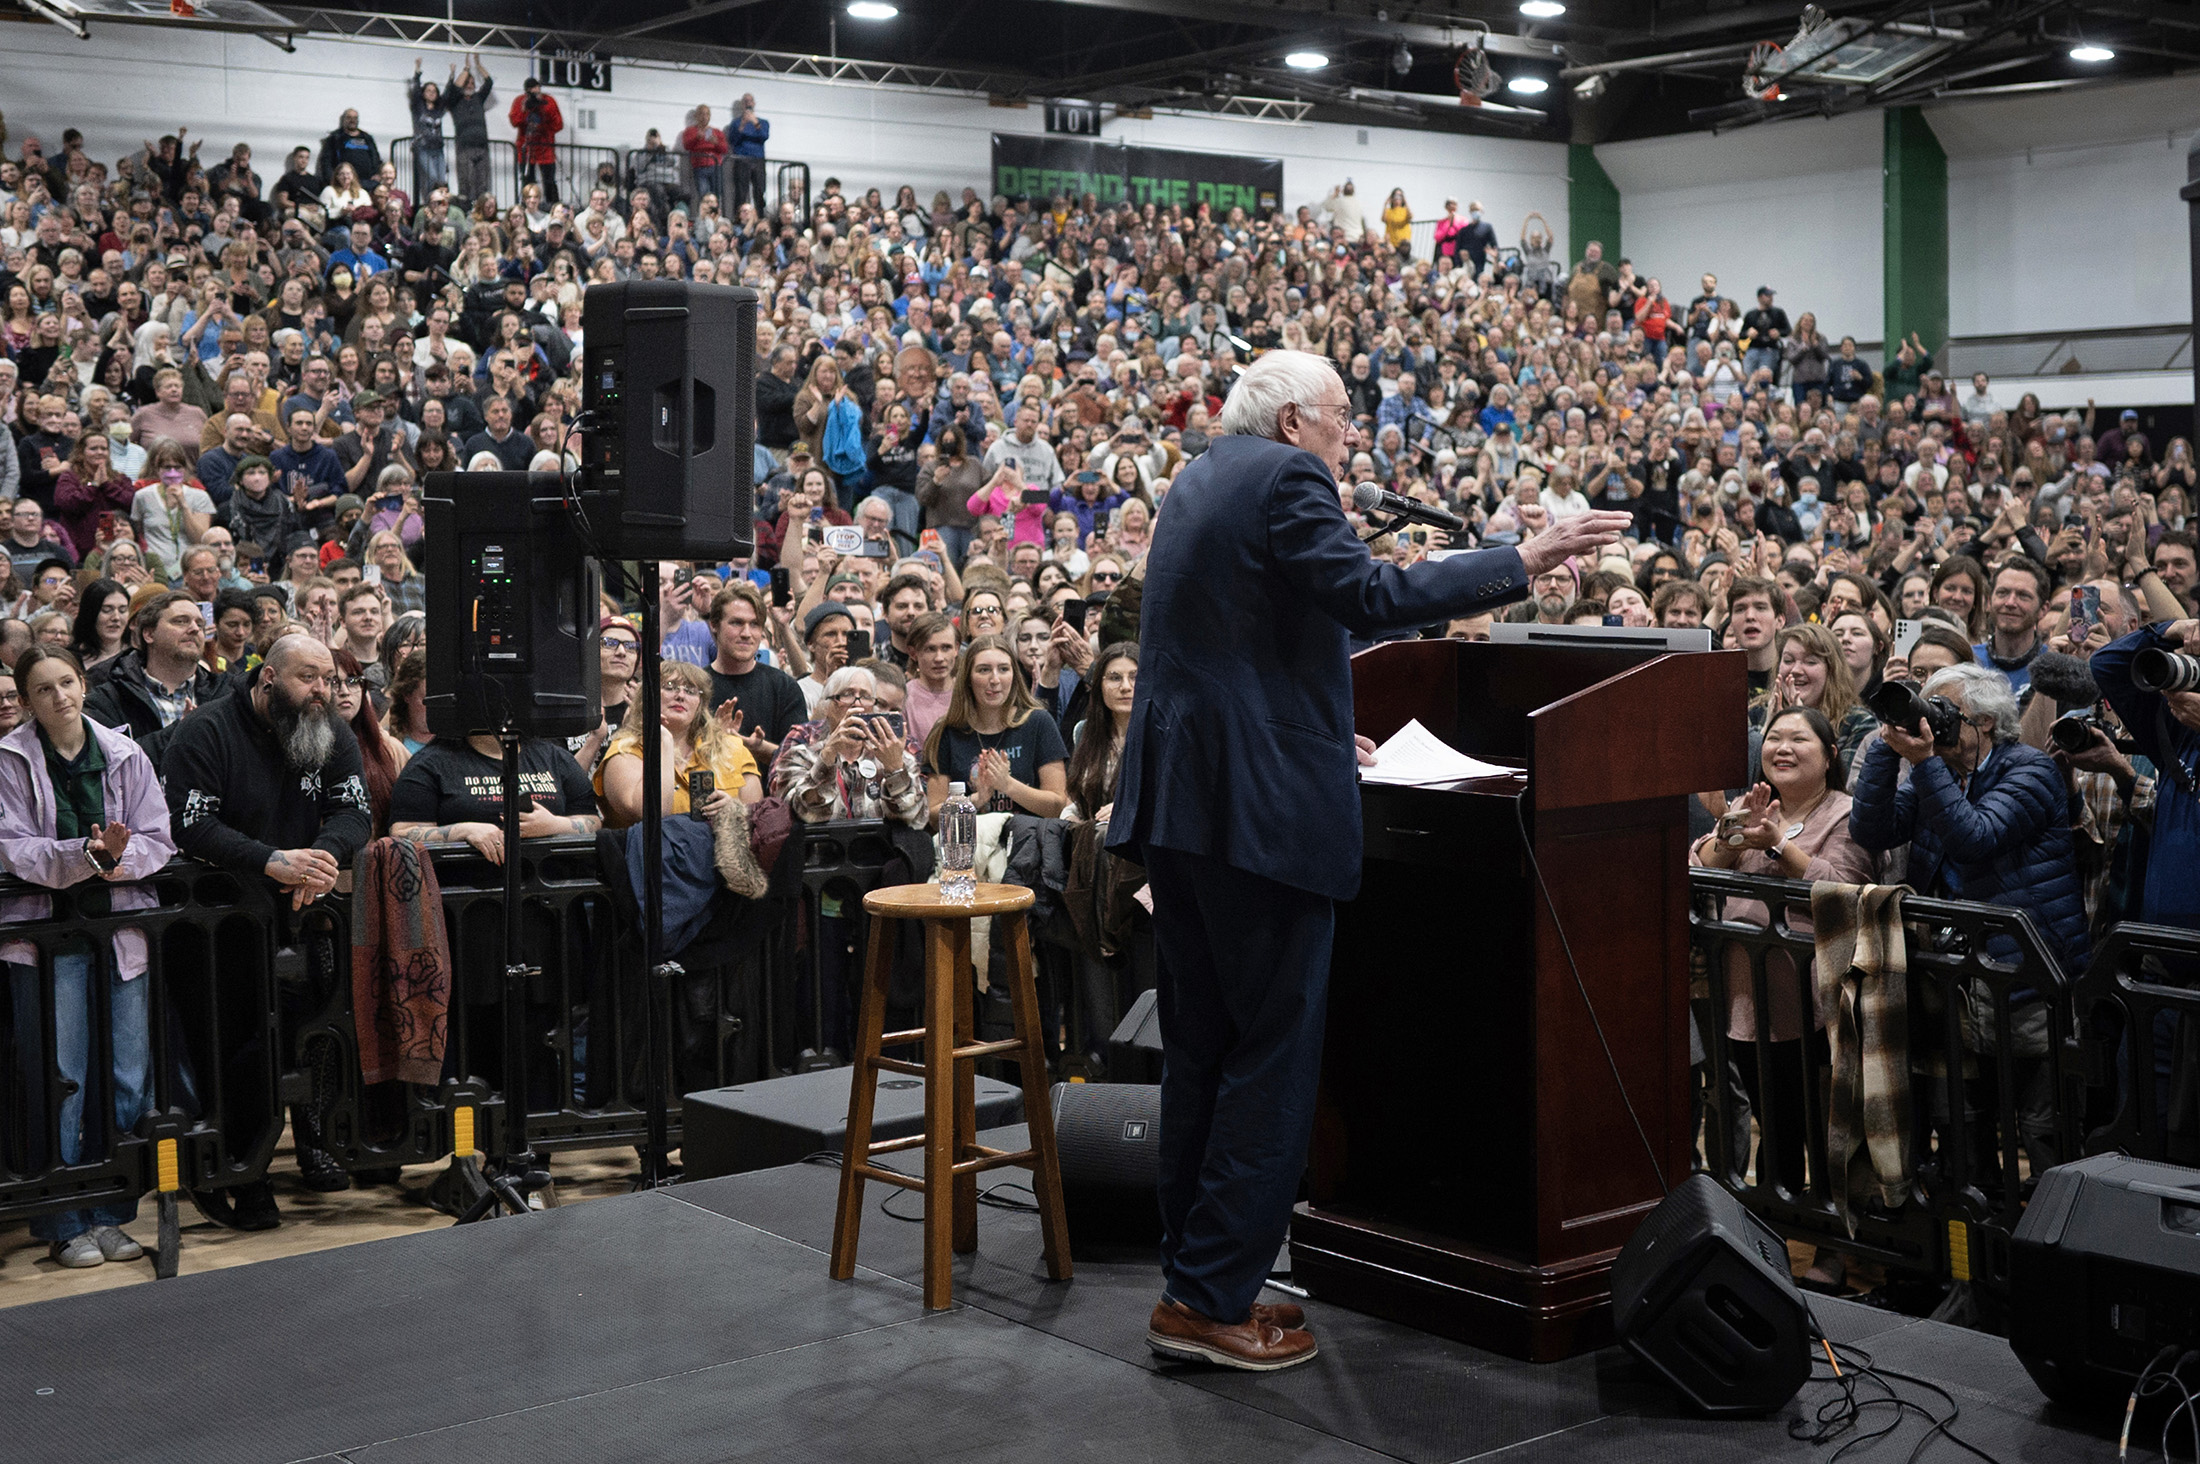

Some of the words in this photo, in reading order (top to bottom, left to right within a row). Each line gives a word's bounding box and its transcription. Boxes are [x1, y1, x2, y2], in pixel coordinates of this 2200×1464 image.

[547, 59, 604, 88] 103
[1053, 107, 1094, 133] 101
[998, 166, 1125, 202] DEFEND
[1130, 176, 1190, 208] THE
[1196, 182, 1257, 213] DEN
